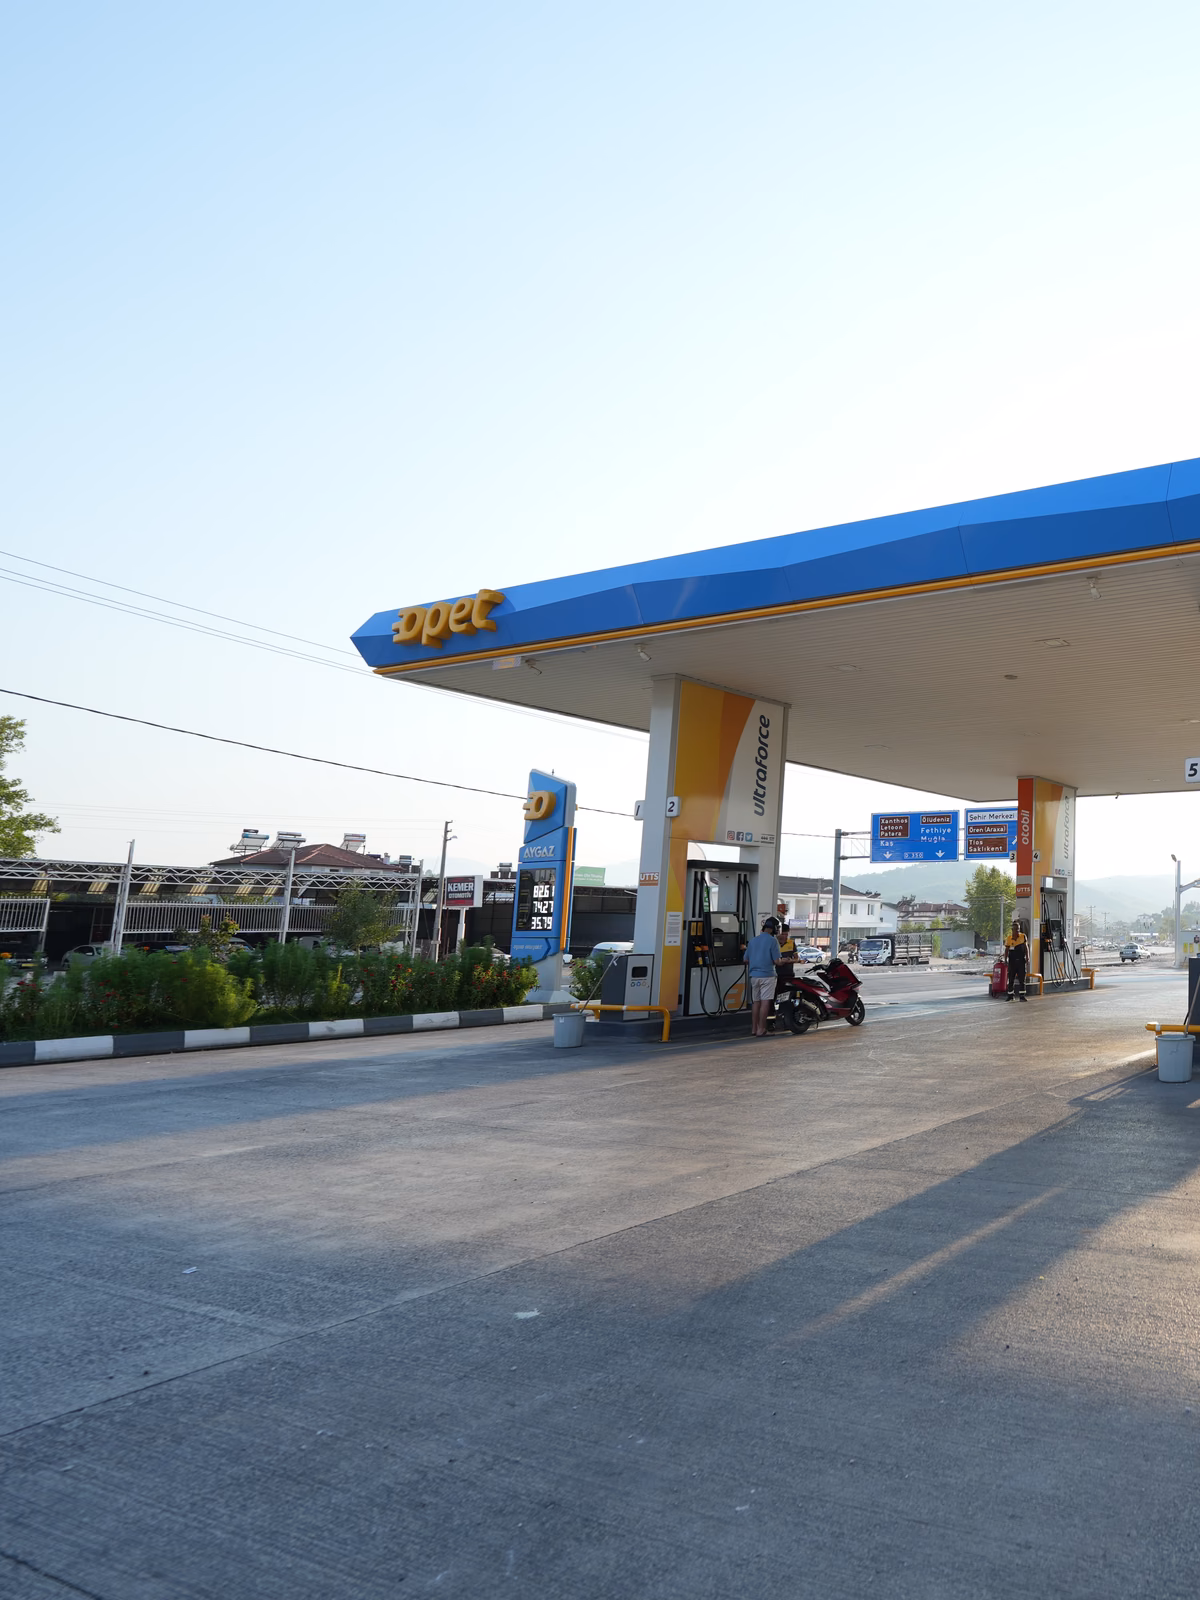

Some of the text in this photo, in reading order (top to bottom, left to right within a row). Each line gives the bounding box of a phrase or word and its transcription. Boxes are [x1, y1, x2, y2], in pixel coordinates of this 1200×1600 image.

[391, 588, 505, 648] opet
[752, 714, 770, 817] ultraforce
[1187, 762, 1199, 777] 5
[667, 801, 675, 812] 2
[988, 812, 1015, 820] Merkezi
[984, 825, 1006, 833] (Araxa)
[1020, 809, 1030, 845] otobil
[920, 836, 946, 844] Muğla
[523, 845, 555, 858] AYGAZ
[1010, 852, 1015, 860] 3
[1033, 852, 1039, 860] 4
[639, 873, 659, 881] UTTS
[447, 882, 474, 892] KEMER
